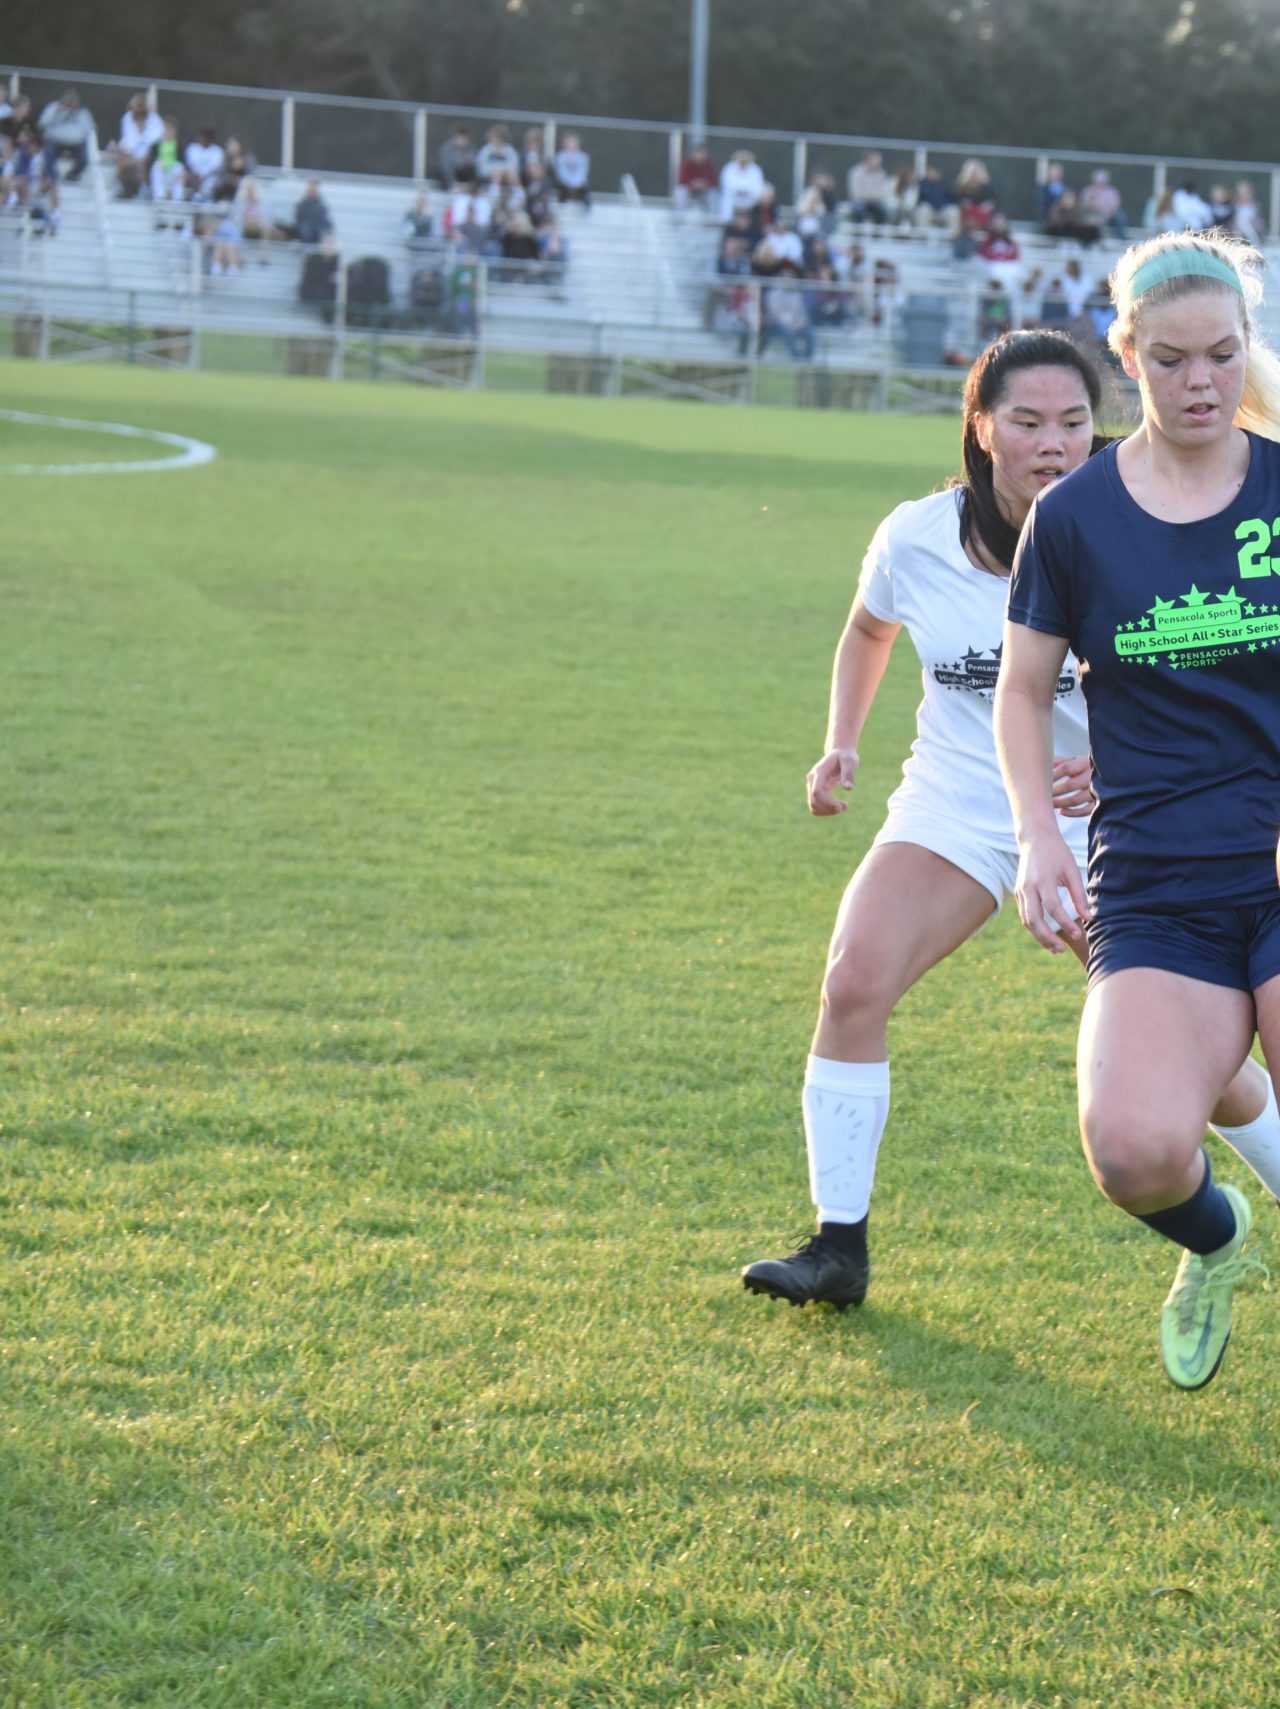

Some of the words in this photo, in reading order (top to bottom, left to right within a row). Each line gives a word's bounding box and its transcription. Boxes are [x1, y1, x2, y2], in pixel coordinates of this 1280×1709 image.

[1158, 611, 1205, 625] Pensacola
[1208, 608, 1238, 621] Sports
[1120, 637, 1146, 651] High
[1150, 632, 1189, 647] School
[1246, 622, 1279, 635] Series
[1180, 648, 1240, 661] PENSACOLA
[967, 663, 1001, 673] Pensaco
